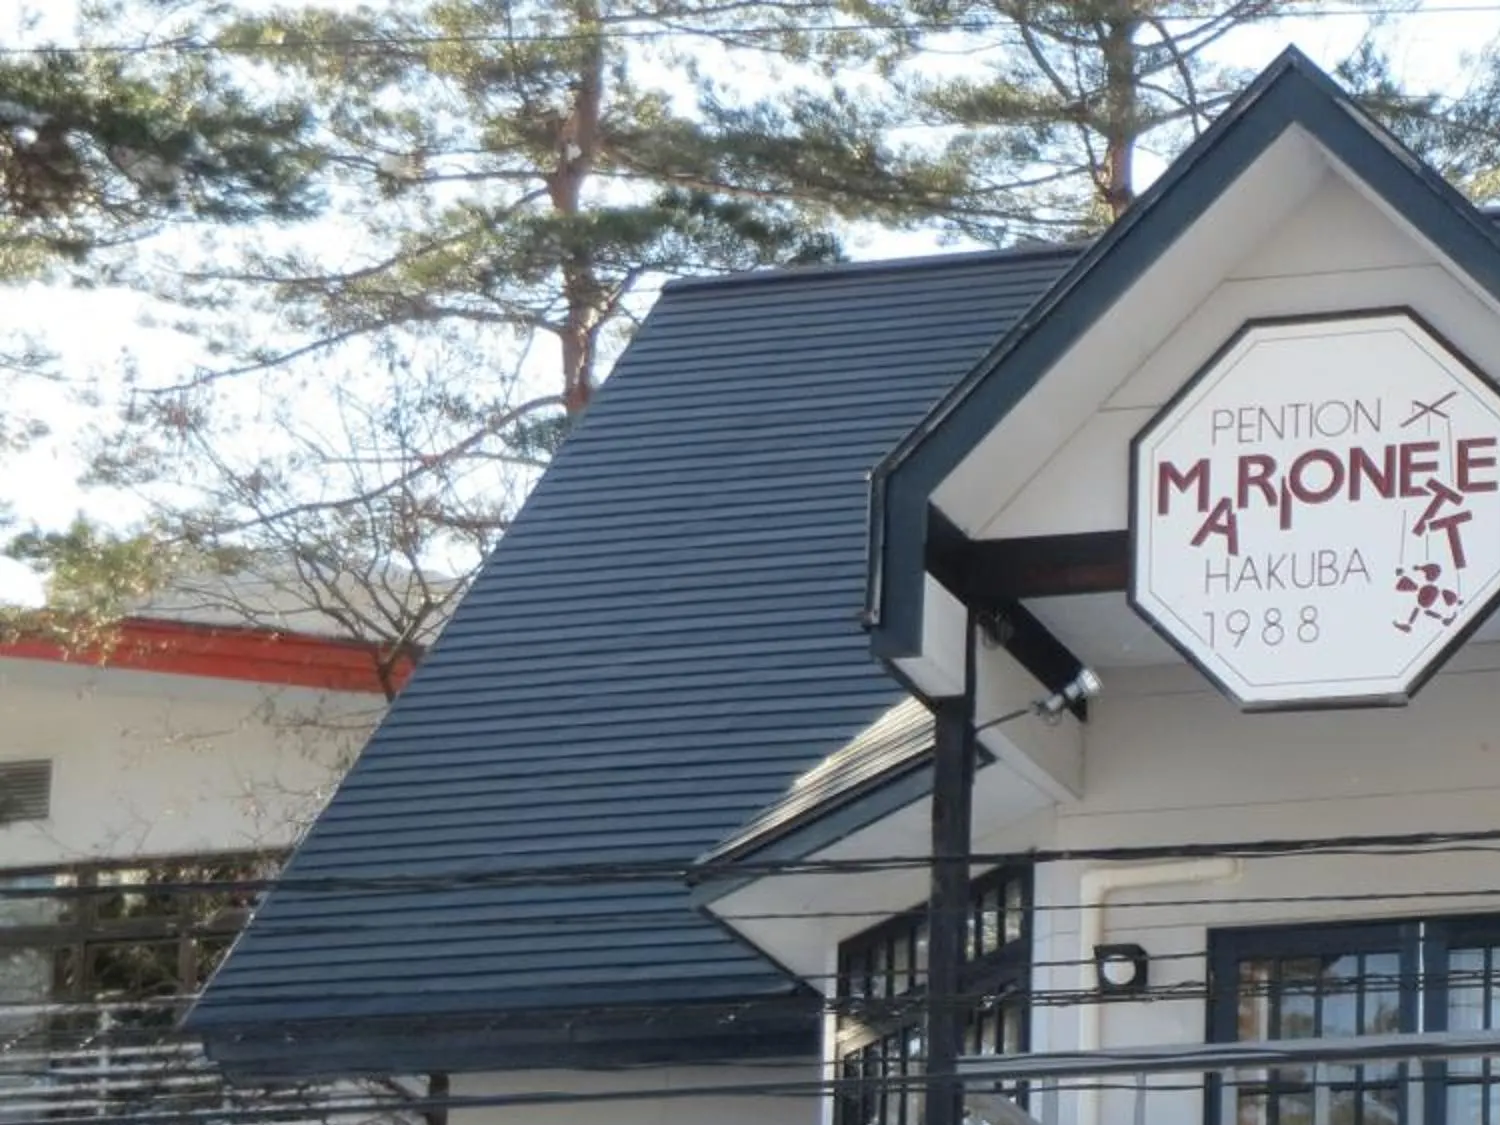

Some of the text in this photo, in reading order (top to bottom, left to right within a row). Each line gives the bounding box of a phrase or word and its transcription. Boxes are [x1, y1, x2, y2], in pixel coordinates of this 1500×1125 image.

[1211, 398, 1382, 446] PENTION
[1158, 436, 1499, 569] MARIONETTE
[1204, 547, 1372, 595] HAKUBA
[1203, 605, 1321, 650] 1988
